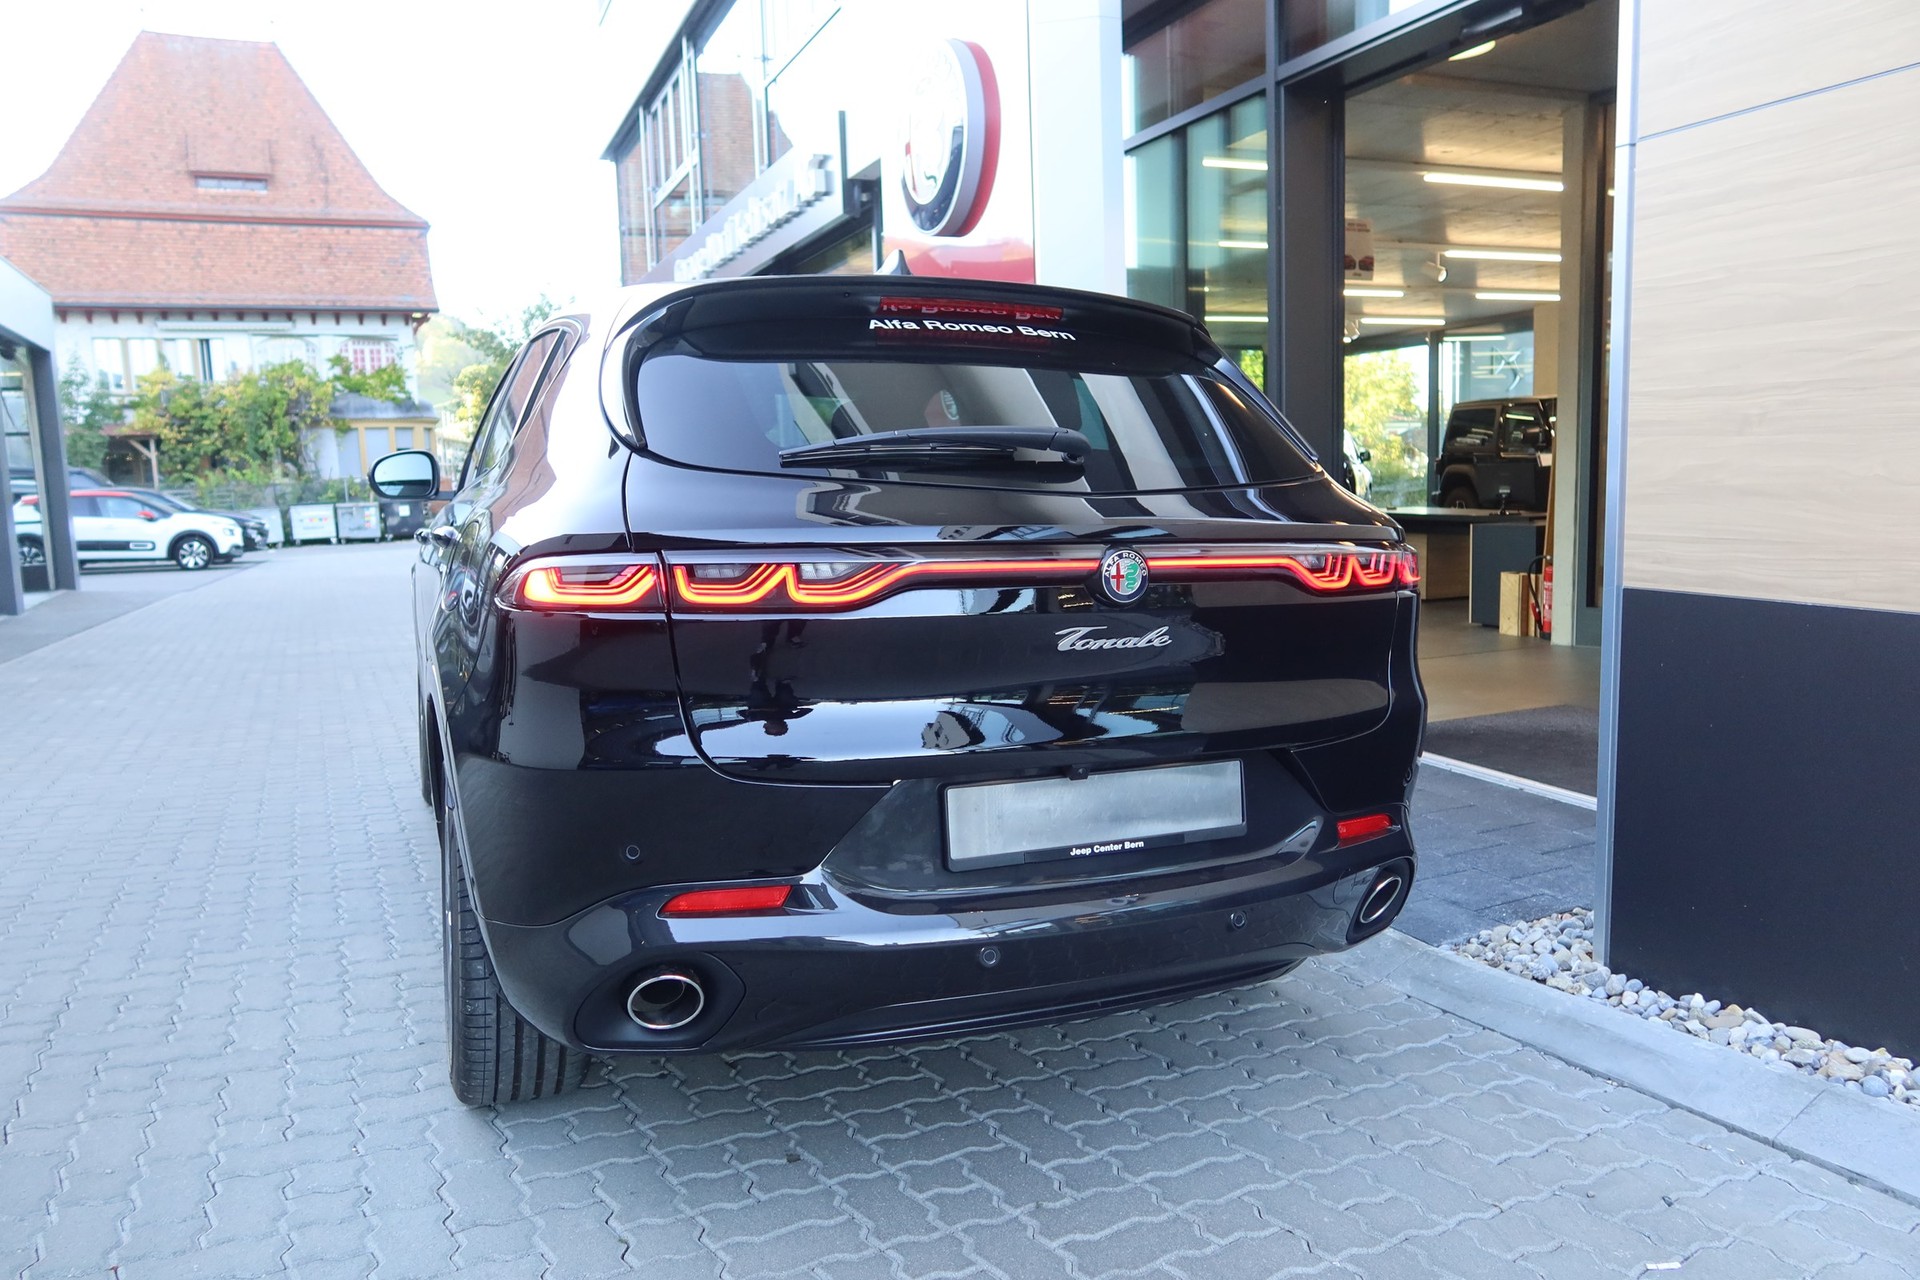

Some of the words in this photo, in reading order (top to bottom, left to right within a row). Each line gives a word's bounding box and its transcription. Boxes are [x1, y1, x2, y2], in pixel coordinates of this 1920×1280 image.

[869, 319, 920, 330] Alfa
[922, 320, 1013, 334] Romeo
[1016, 325, 1076, 341] Bern
[1104, 555, 1120, 578] ALFA
[1122, 552, 1147, 577] ROMEO
[1055, 625, 1172, 651] Tonale
[1069, 847, 1092, 856] Jeep
[1093, 843, 1123, 853] Center
[1124, 841, 1144, 850] Bern
